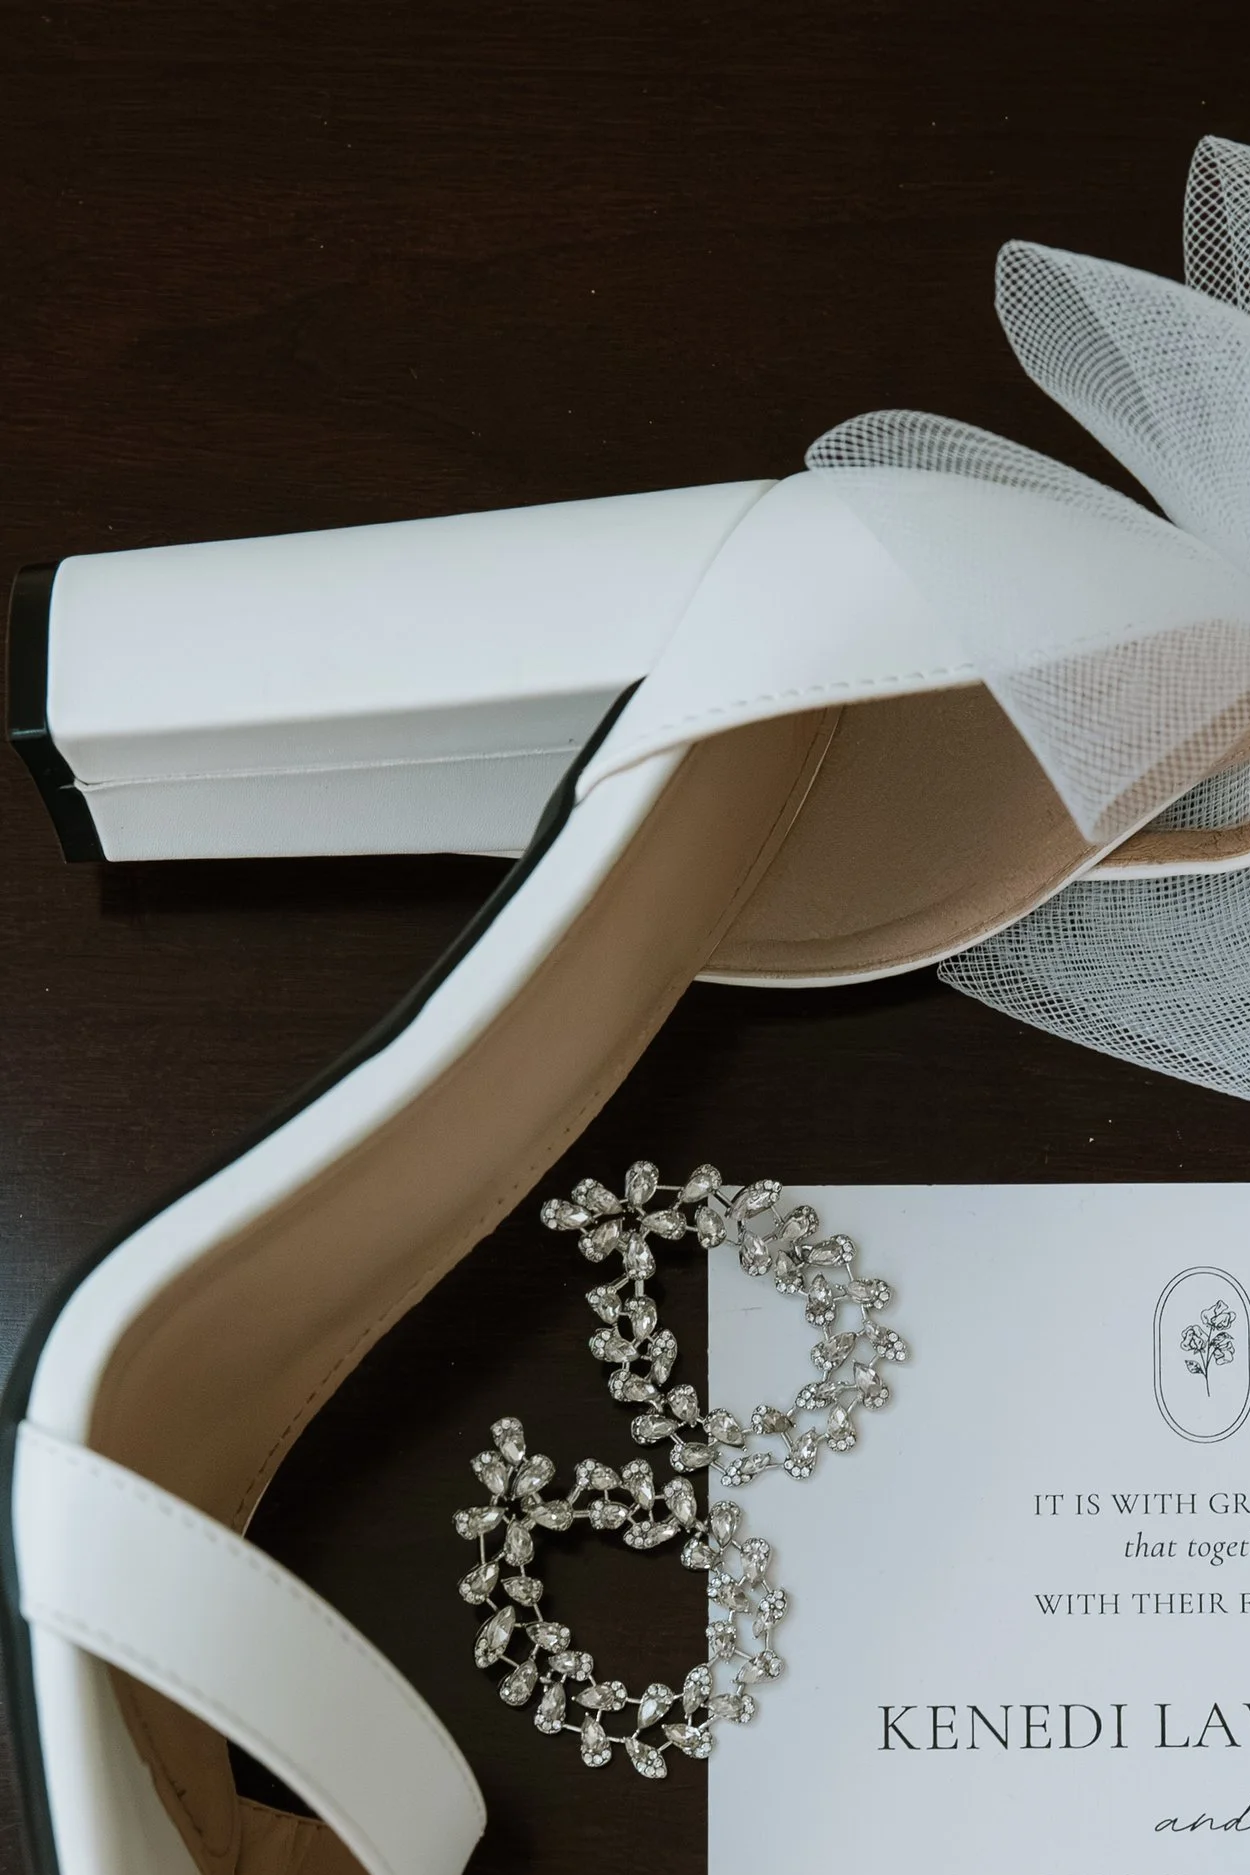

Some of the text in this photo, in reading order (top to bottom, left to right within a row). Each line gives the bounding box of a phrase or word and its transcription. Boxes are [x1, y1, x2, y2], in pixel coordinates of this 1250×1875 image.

[1034, 1493, 1064, 1515] IT
[1075, 1493, 1101, 1515] IS
[1111, 1493, 1197, 1515] WITH
[1124, 1531, 1178, 1558] that
[1034, 1593, 1120, 1615] WITH
[1131, 1592, 1229, 1615] THEIR
[877, 1703, 1129, 1751] KENEDI
